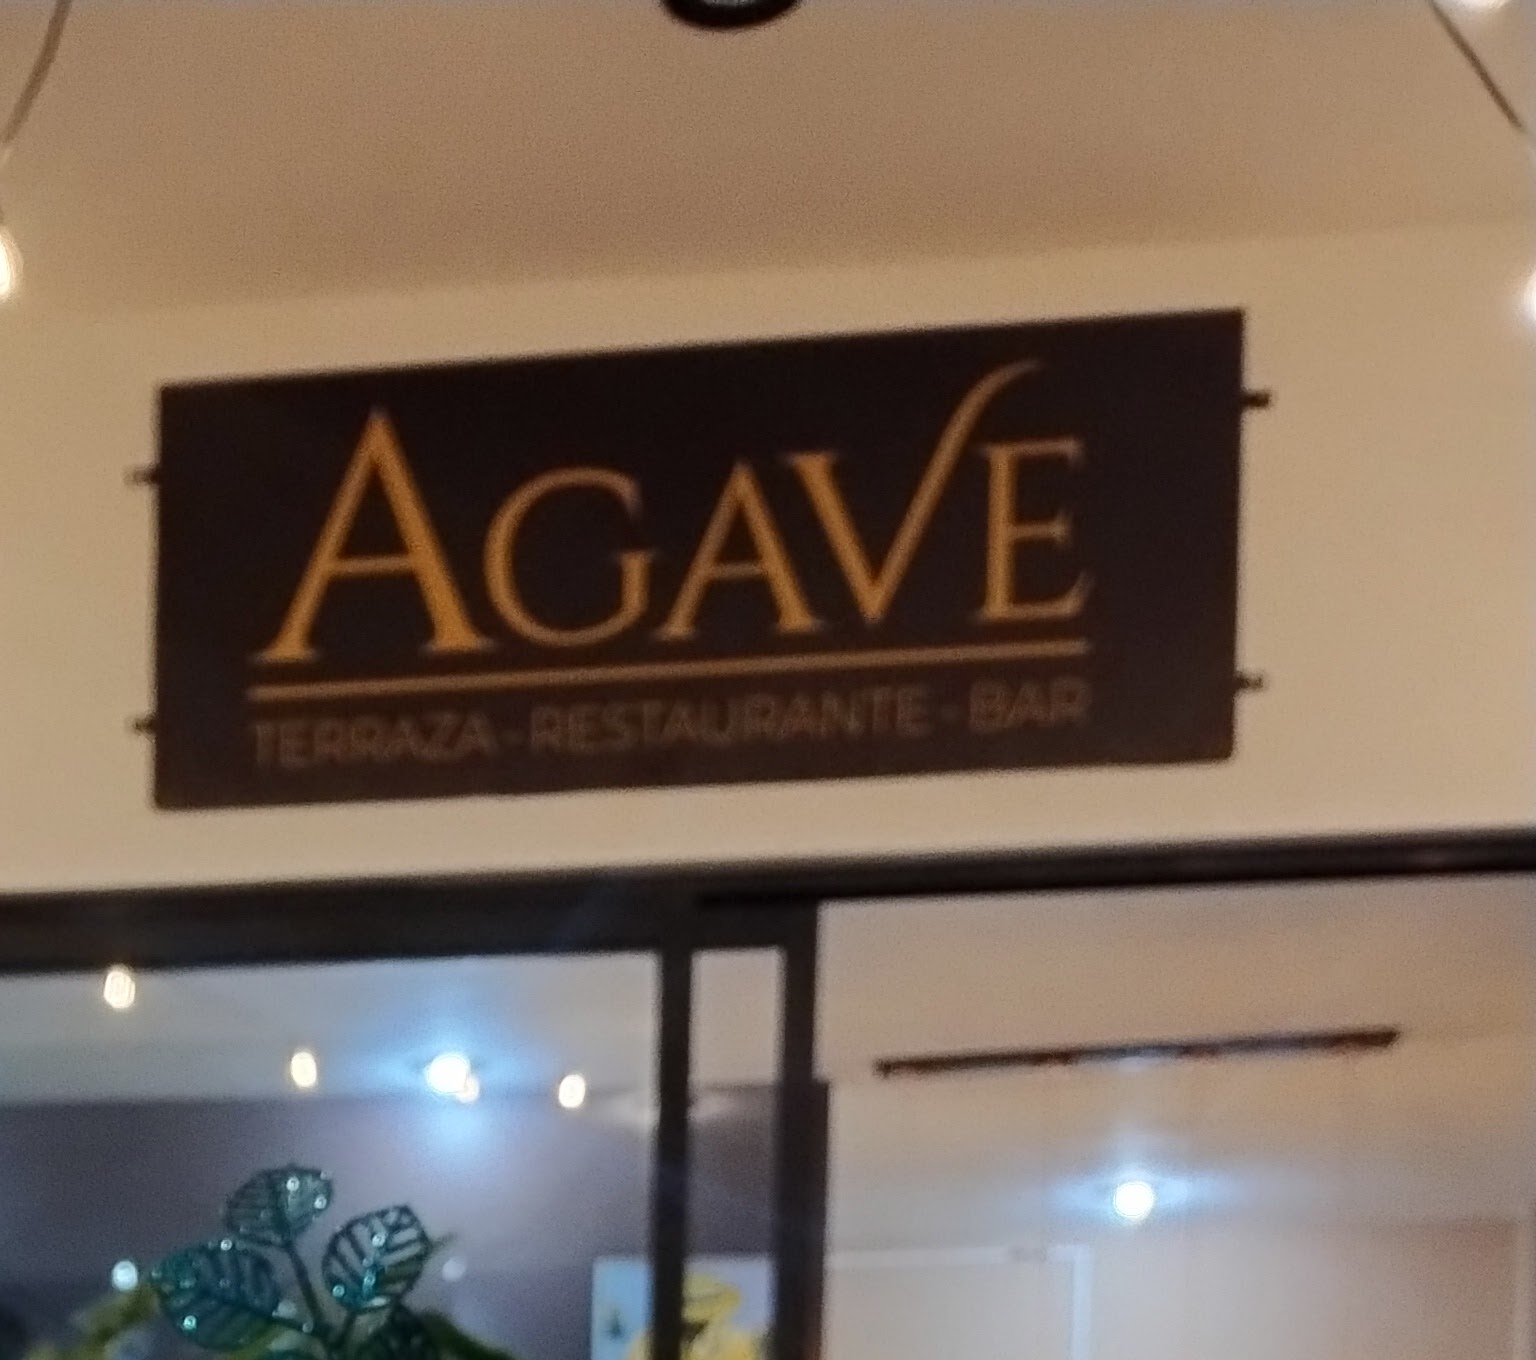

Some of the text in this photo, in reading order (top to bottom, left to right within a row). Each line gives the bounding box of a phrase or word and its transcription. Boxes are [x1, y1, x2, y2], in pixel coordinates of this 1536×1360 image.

[251, 357, 1093, 664] AGAVE
[254, 676, 1091, 768] TERRAZA RESTAURANTE BAR
